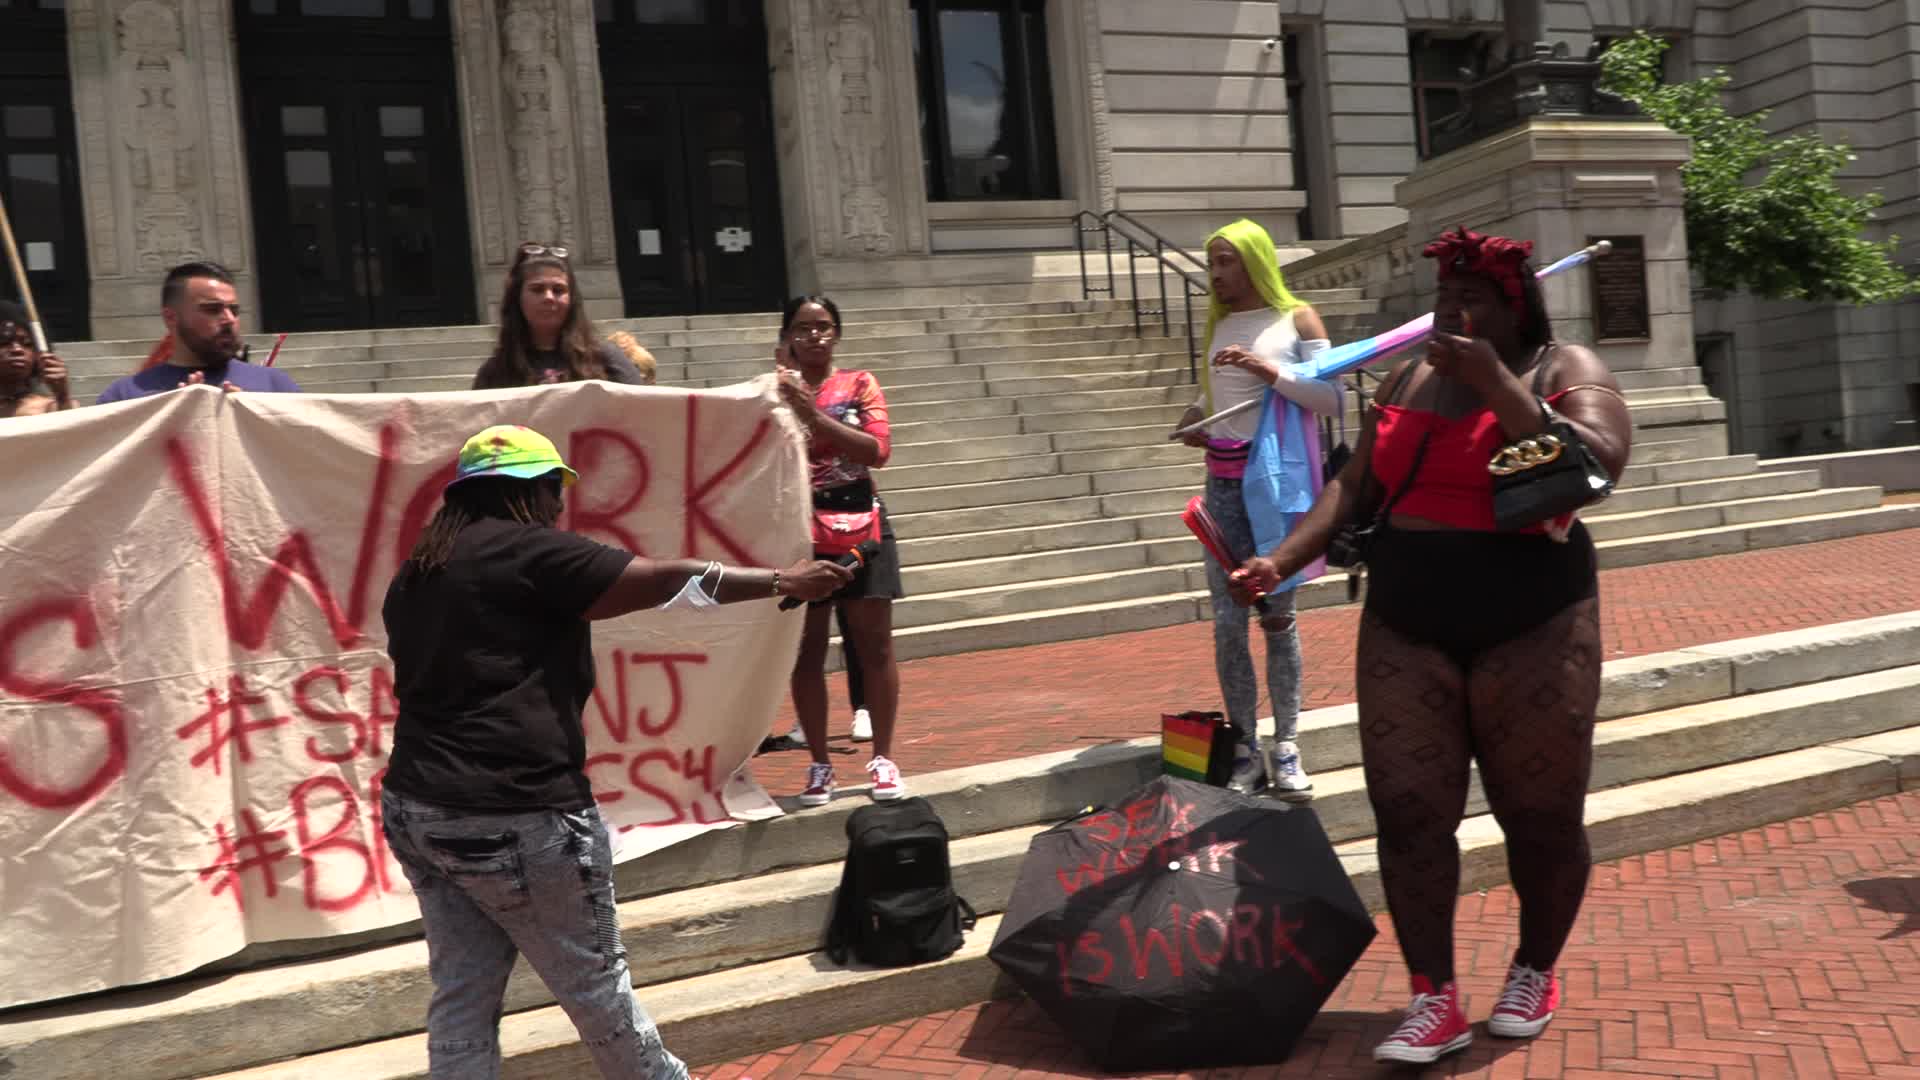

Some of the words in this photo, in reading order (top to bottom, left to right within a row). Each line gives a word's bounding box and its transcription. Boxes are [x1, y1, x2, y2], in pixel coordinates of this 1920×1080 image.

[1077, 792, 1197, 842] SEX
[1057, 933, 1115, 997] IS
[1120, 903, 1327, 985] WORK
